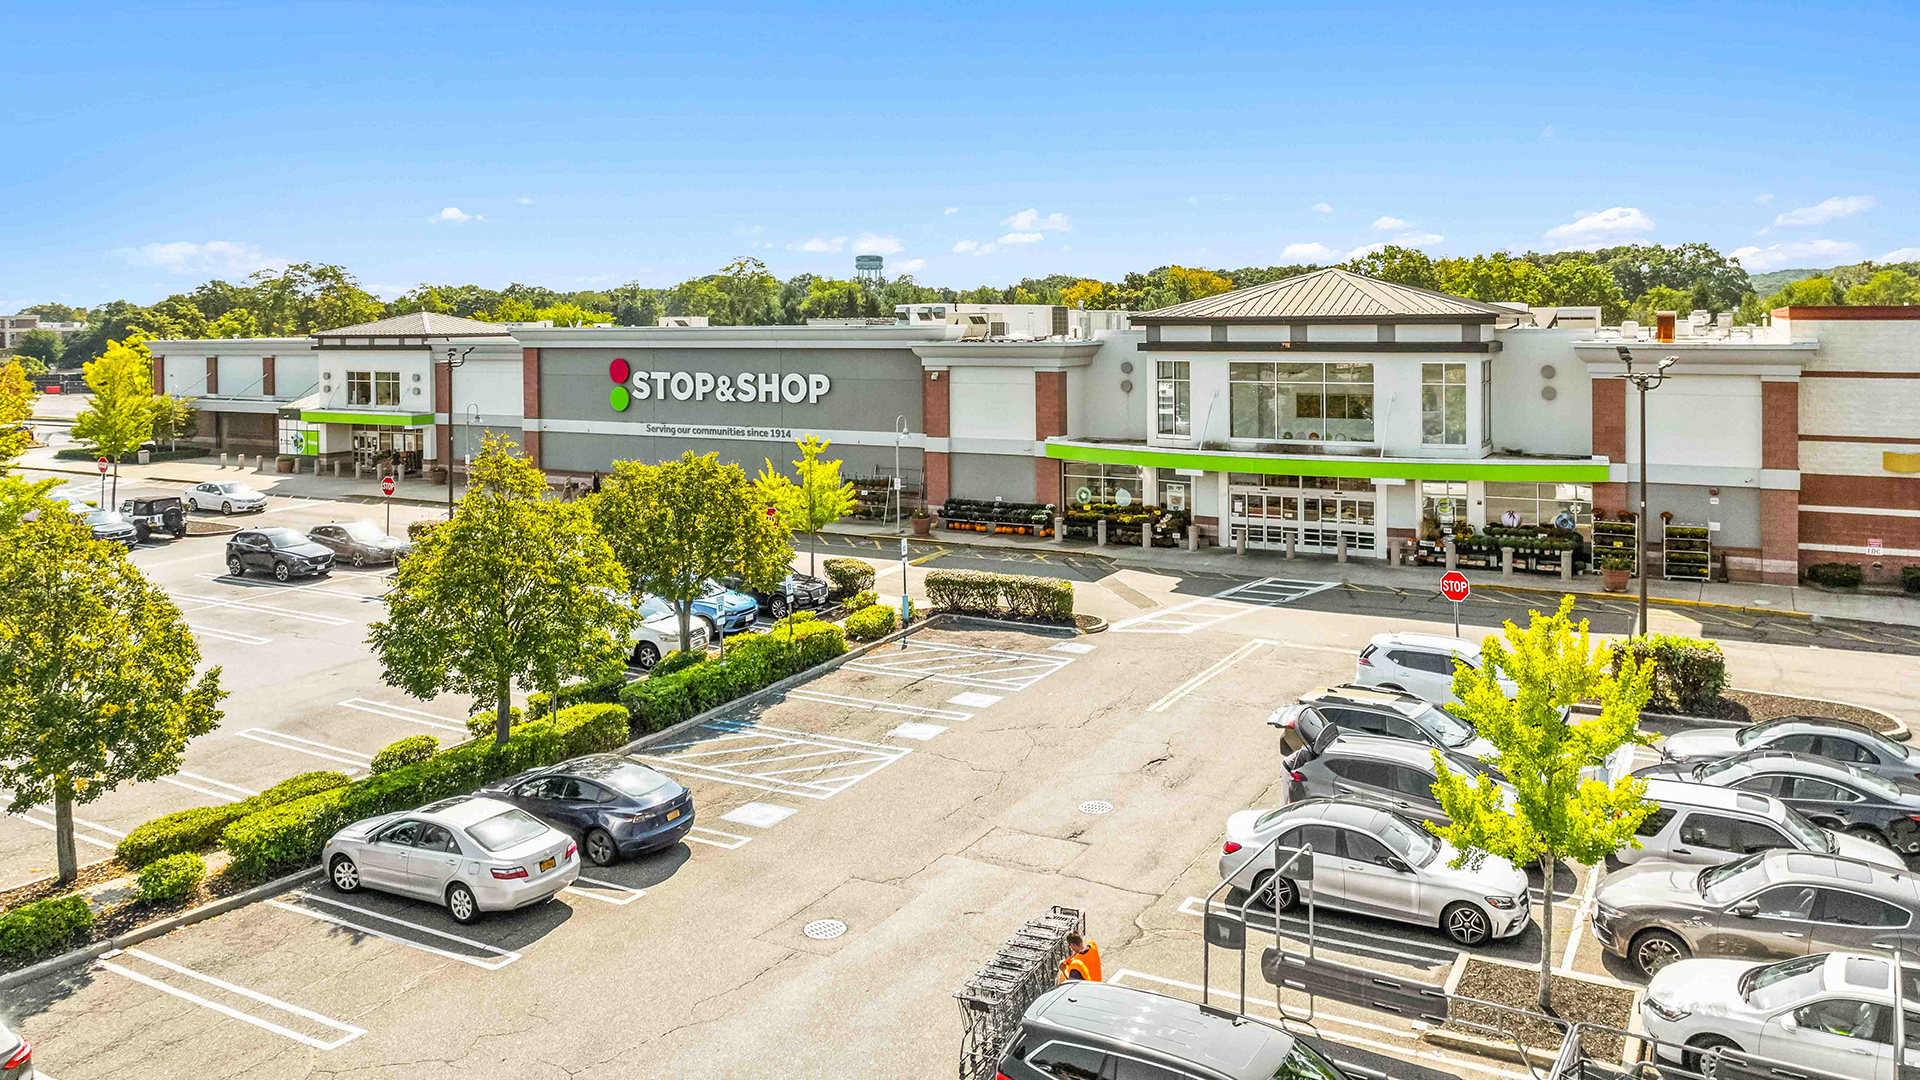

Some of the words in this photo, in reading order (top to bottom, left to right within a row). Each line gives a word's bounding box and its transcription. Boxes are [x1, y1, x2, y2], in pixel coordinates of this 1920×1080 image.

[632, 371, 830, 404] STOP&SHOP
[646, 424, 676, 435] Serving
[677, 427, 691, 435] our
[692, 427, 746, 437] communities
[746, 428, 769, 438] since
[770, 429, 792, 438] 1914
[1443, 580, 1467, 593] STOP
